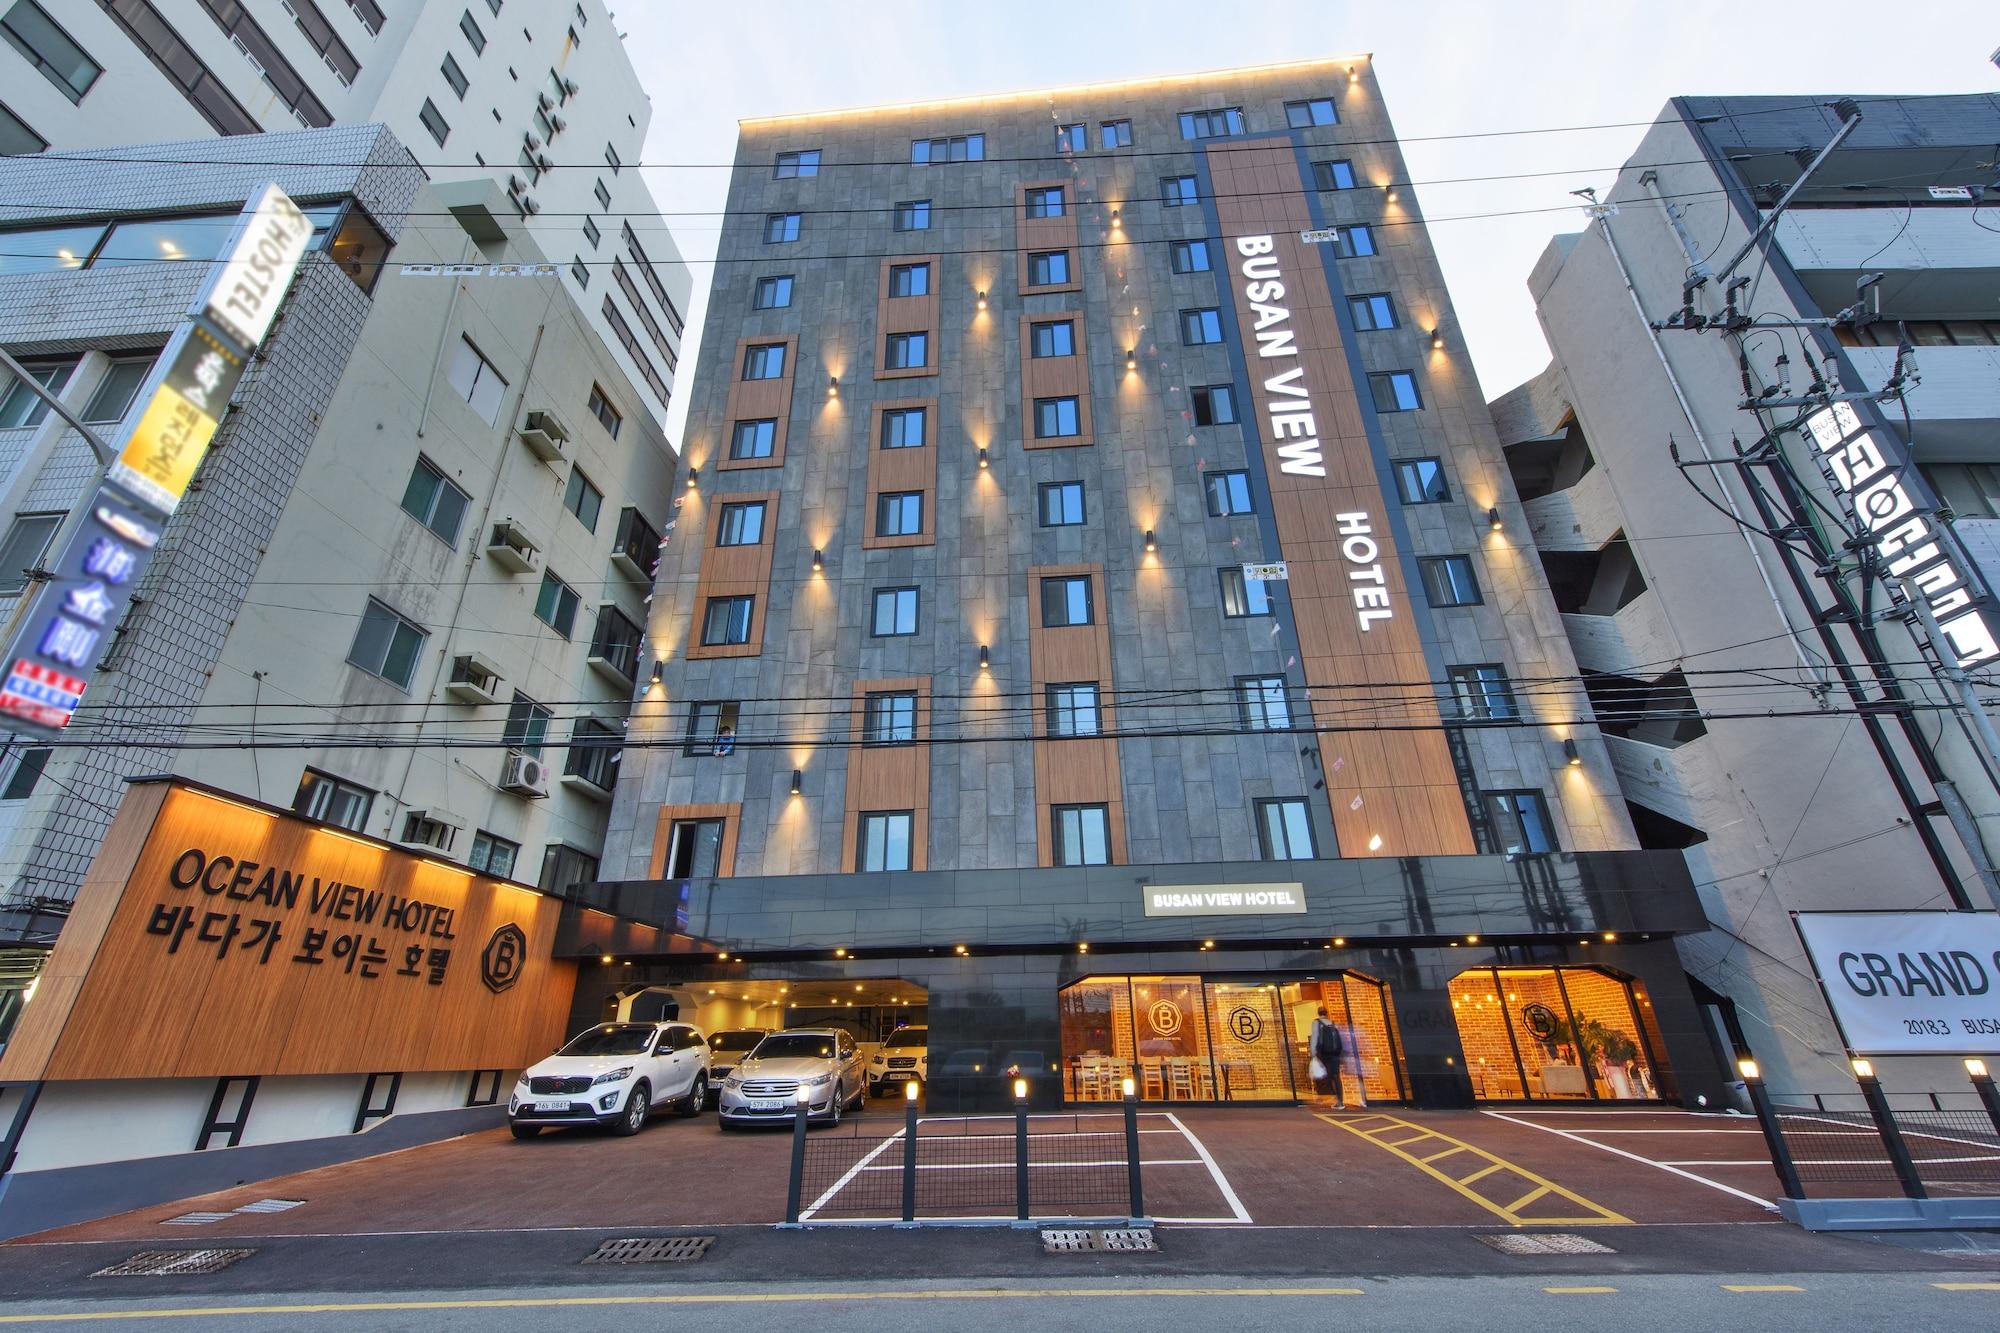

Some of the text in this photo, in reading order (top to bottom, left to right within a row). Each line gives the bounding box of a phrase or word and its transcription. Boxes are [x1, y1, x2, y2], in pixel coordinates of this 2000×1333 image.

[225, 218, 293, 320] HOSTEL
[1237, 234, 1326, 477] BUSAN VIEW
[1813, 402, 1850, 434] BUSAN
[1822, 415, 1851, 440] VIEW
[1336, 511, 1393, 631] HOTEL
[170, 848, 456, 939] OCEAN VIEW HOTEL
[1153, 891, 1296, 908] BUSAN VIEW HOTEL
[147, 903, 450, 985] 바다가 보이는 호텔
[1839, 951, 1989, 996] GRAND
